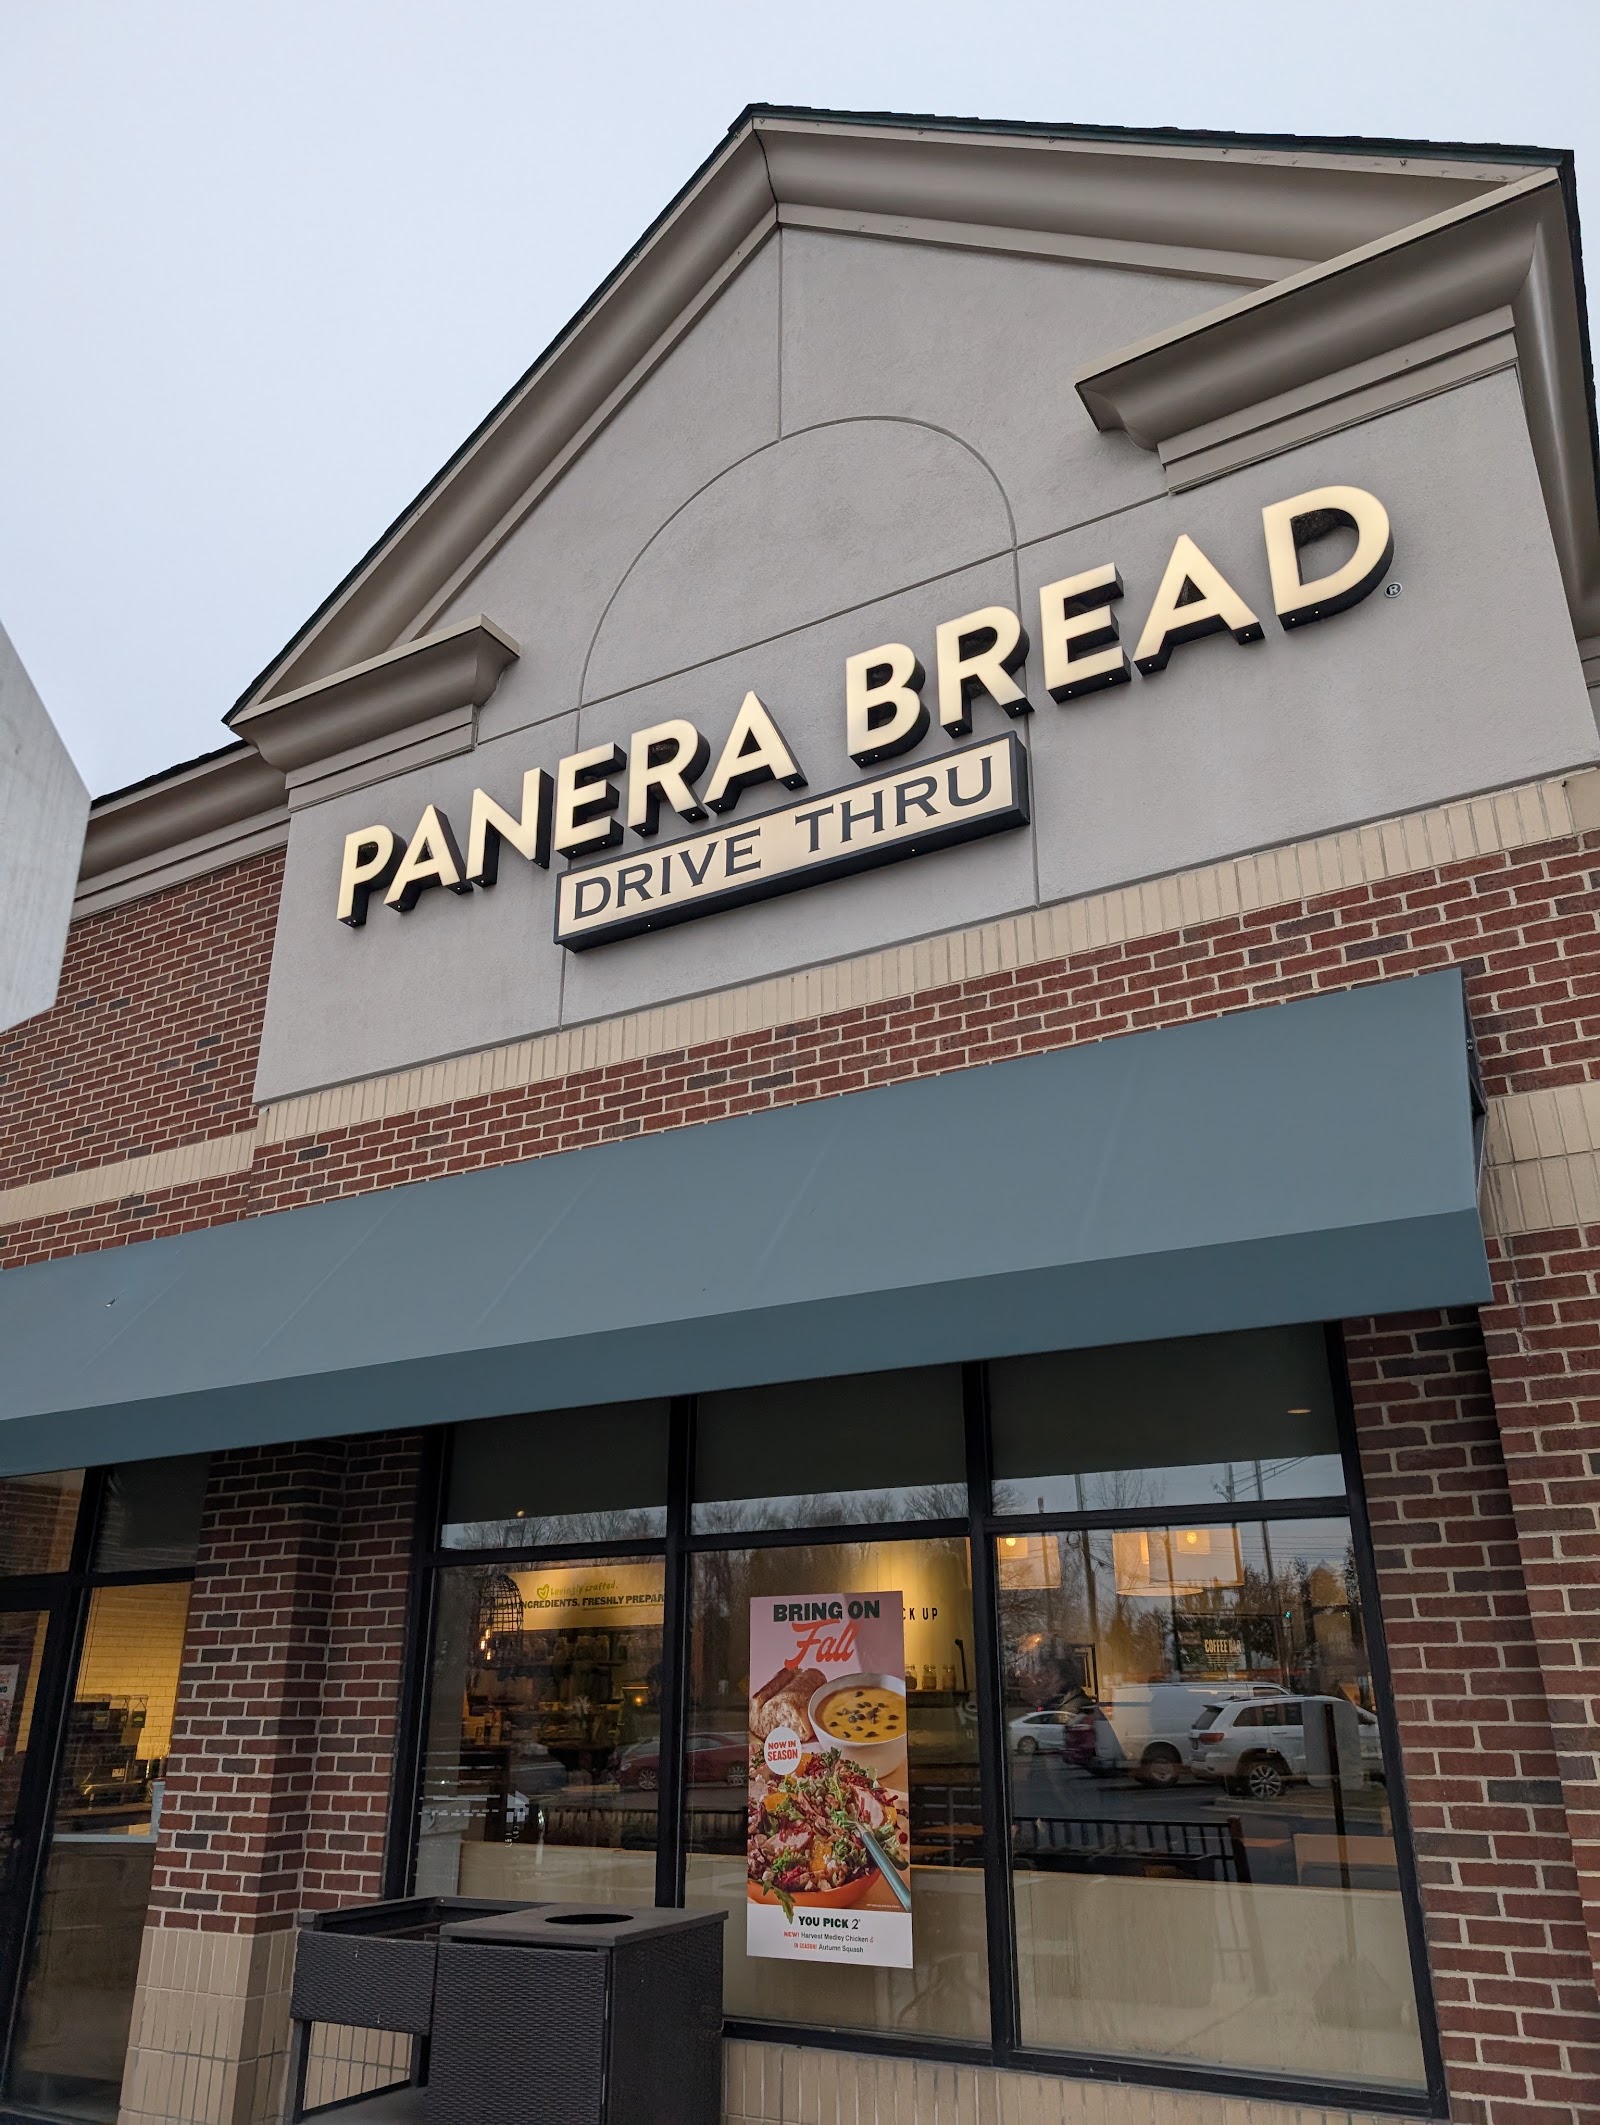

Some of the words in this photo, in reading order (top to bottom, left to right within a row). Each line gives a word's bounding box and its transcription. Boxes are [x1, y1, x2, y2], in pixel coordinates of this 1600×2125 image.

[336, 690, 808, 928] PANERA
[846, 485, 1394, 768] BREAD
[573, 826, 762, 921] DRIVE
[795, 755, 993, 854] THRU
[520, 1598, 580, 1610] NGREDIENTS.
[582, 1595, 624, 1606] FRESHLY
[773, 1602, 843, 1622] BRING
[847, 1599, 880, 1619] ON
[922, 1607, 938, 1621] UP
[784, 1619, 860, 1670] Fall
[1204, 1639, 1228, 1653] COFFEE
[768, 1741, 786, 1749] NOW
[768, 1749, 798, 1761] SEASON
[798, 1916, 820, 1926] YOU
[823, 1918, 849, 1928] PICK
[801, 1932, 823, 1940] Harvest
[824, 1934, 845, 1942] Medley
[845, 1935, 869, 1943] Chicken
